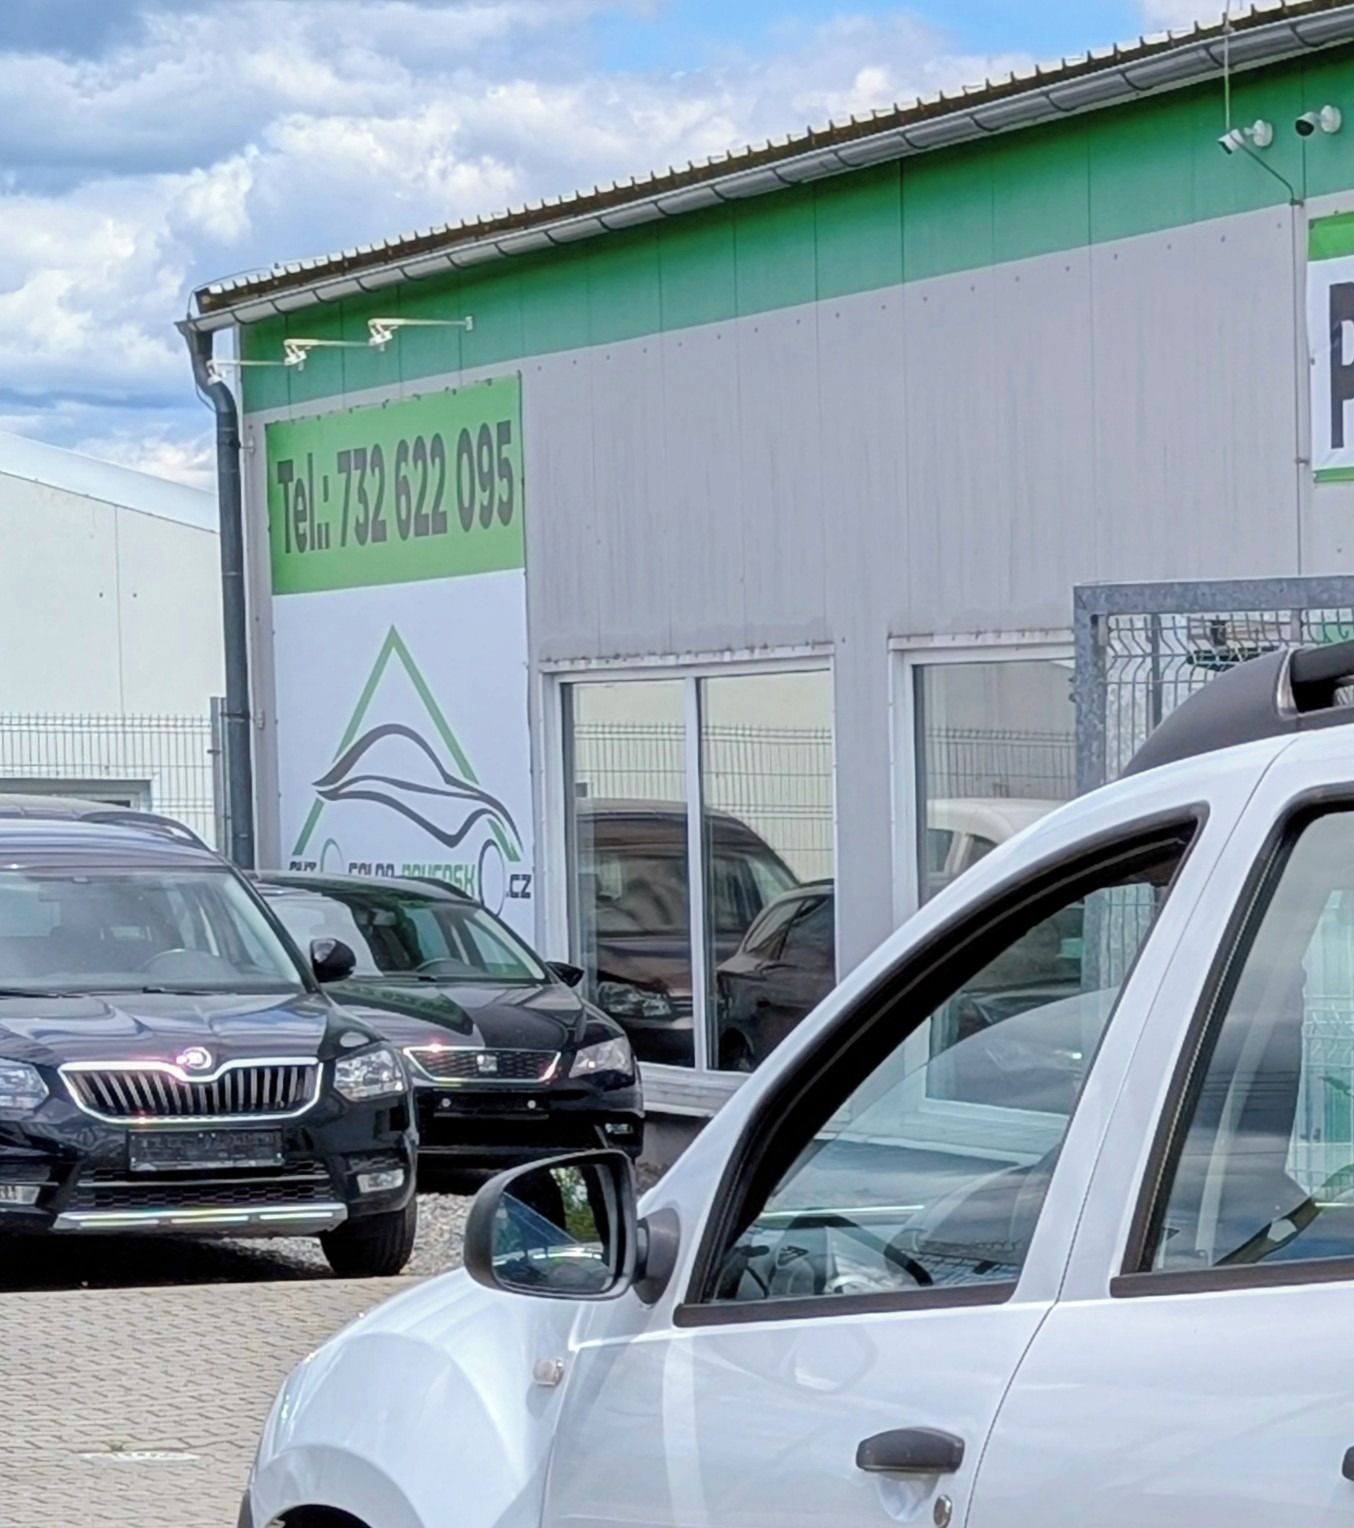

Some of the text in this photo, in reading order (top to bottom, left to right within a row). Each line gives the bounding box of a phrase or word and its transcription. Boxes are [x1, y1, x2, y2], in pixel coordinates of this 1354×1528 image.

[277, 419, 514, 555] Tel.: 732 622 095
